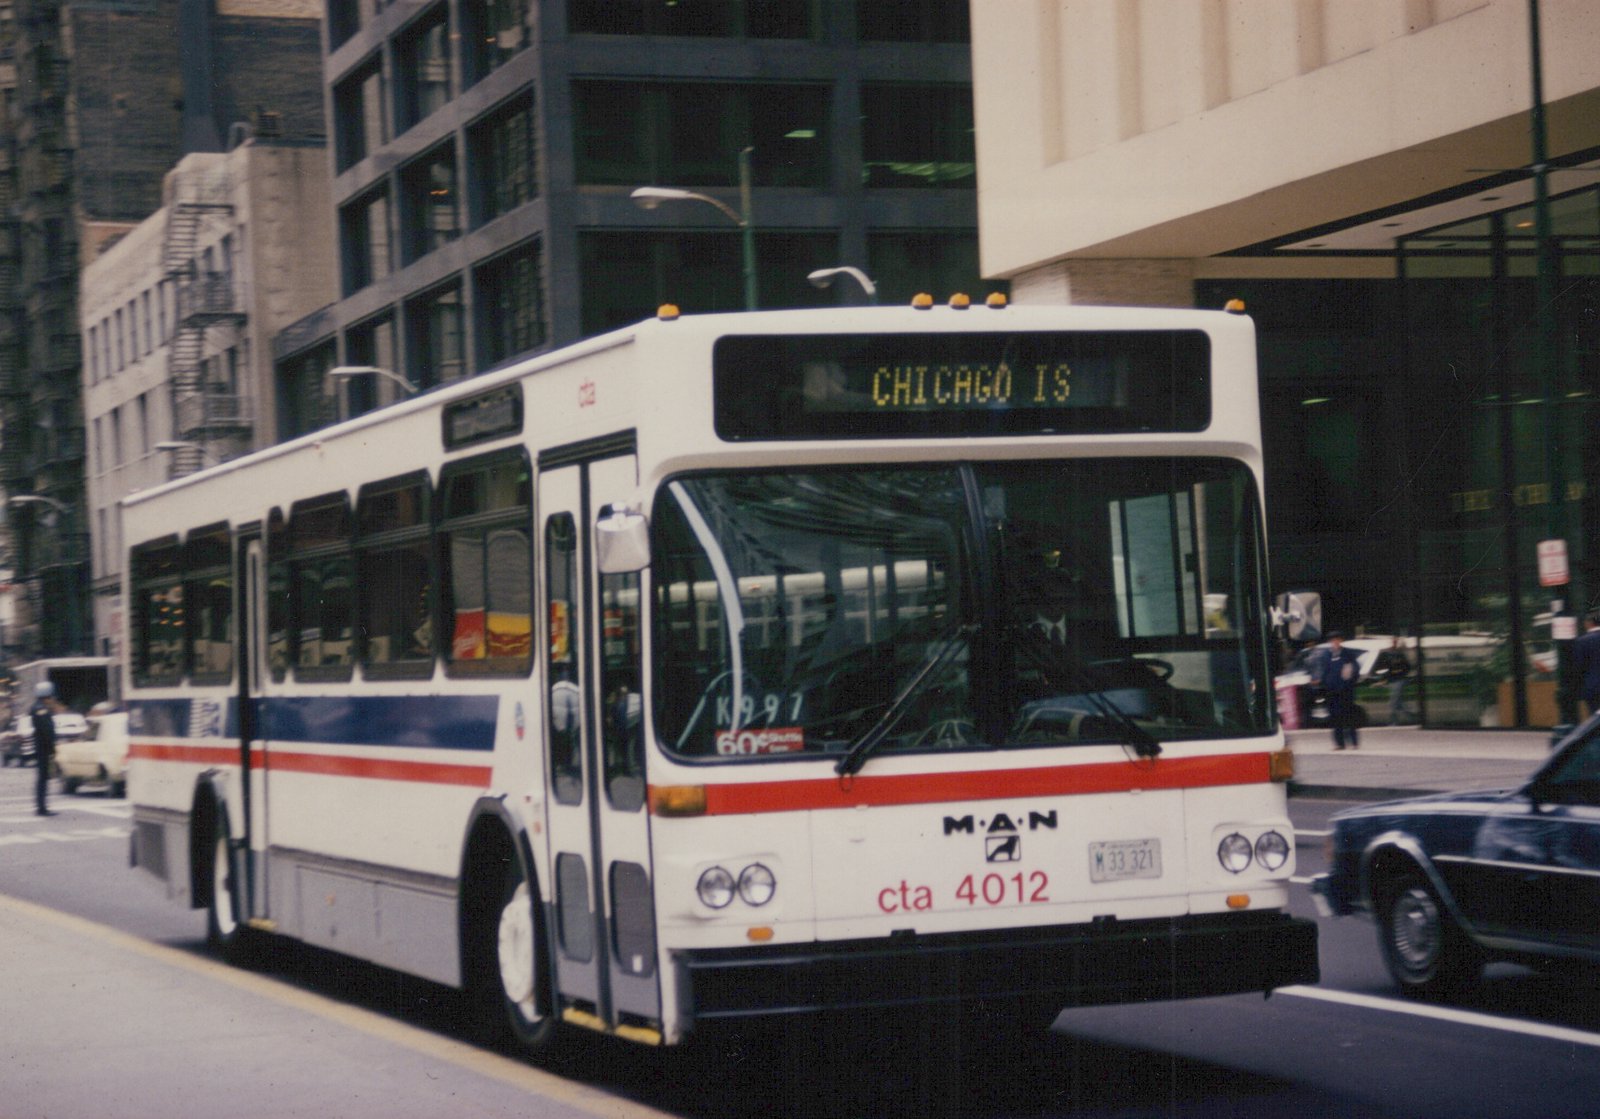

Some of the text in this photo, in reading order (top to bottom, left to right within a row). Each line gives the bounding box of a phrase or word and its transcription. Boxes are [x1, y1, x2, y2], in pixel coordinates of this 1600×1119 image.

[873, 363, 1071, 406] CHICAGO IS
[1108, 850, 1125, 872] 33
[1130, 848, 1153, 871] 321
[877, 871, 1050, 913] cta 4012
